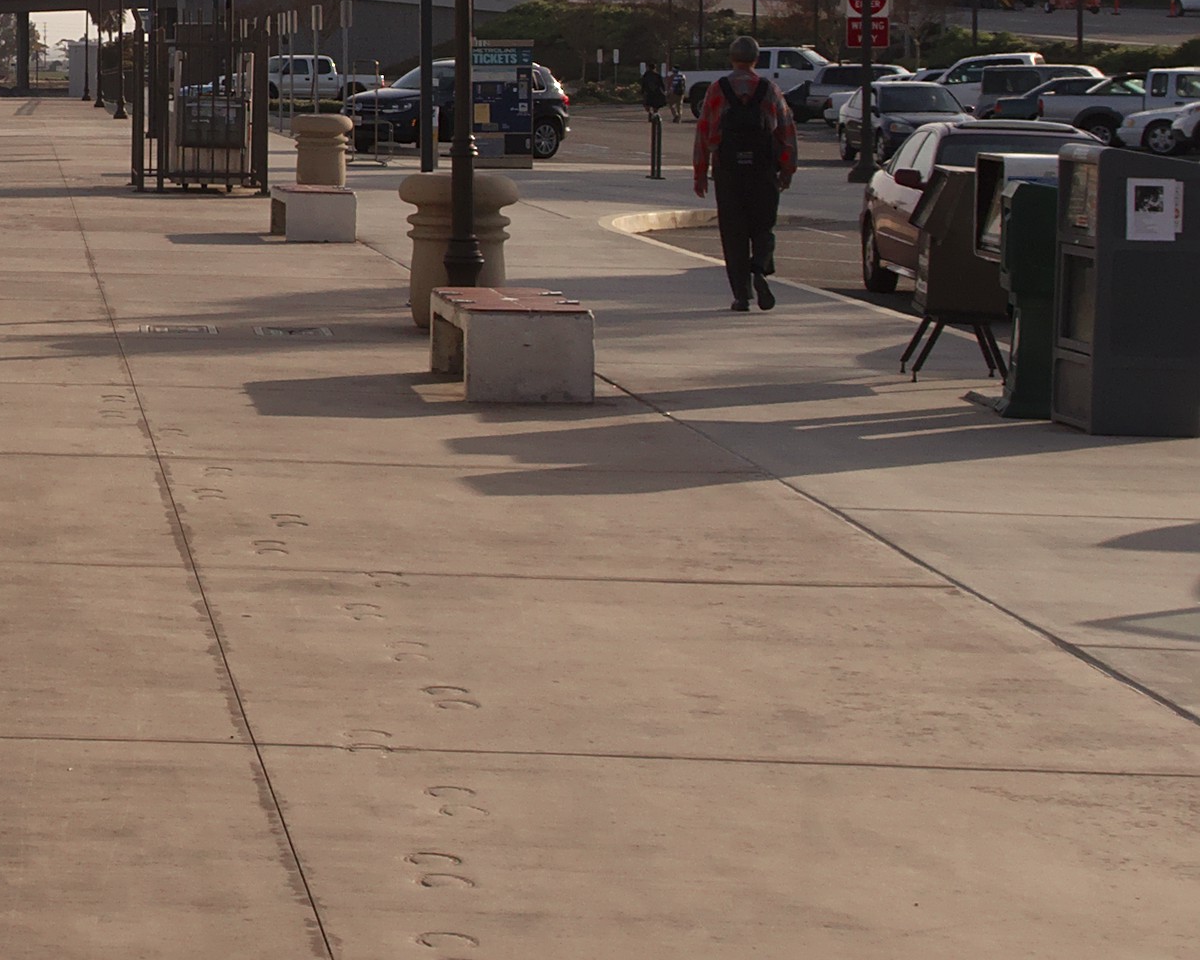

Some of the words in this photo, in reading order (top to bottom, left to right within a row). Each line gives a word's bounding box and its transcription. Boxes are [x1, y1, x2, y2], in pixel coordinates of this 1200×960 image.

[855, 0, 881, 8] EER
[851, 21, 885, 30] WRNG
[857, 34, 878, 43] WY
[472, 53, 518, 64] TICKETS
